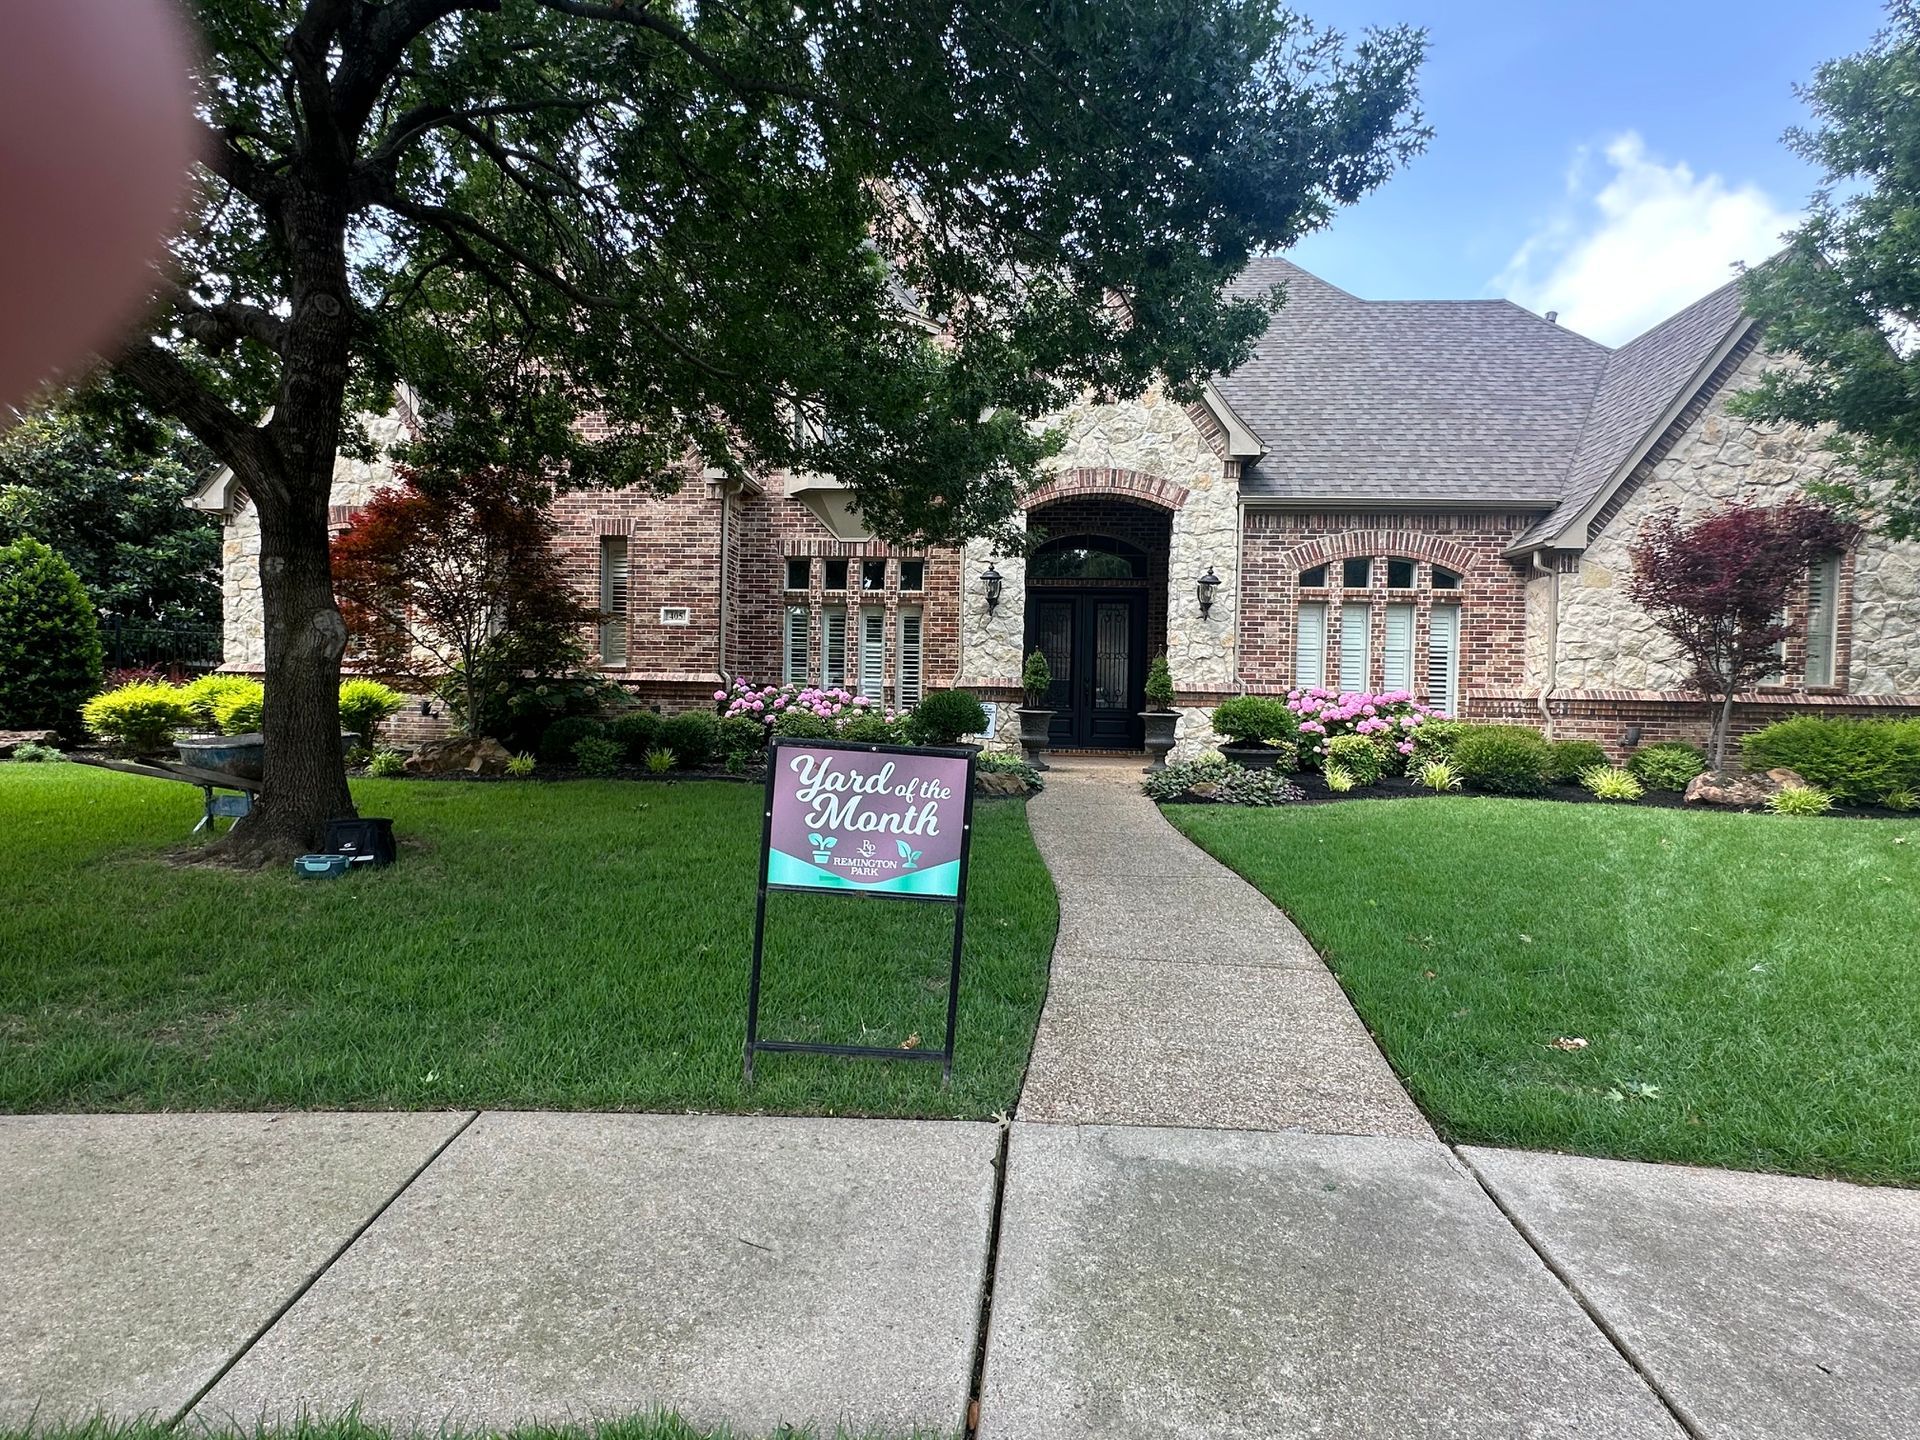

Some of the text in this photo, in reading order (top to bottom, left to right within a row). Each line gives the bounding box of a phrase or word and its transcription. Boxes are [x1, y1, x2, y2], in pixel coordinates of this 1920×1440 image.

[789, 754, 951, 803] Yard of the
[804, 792, 940, 836] Month
[833, 857, 898, 869] REMINGTON
[850, 866, 879, 876] PARK
